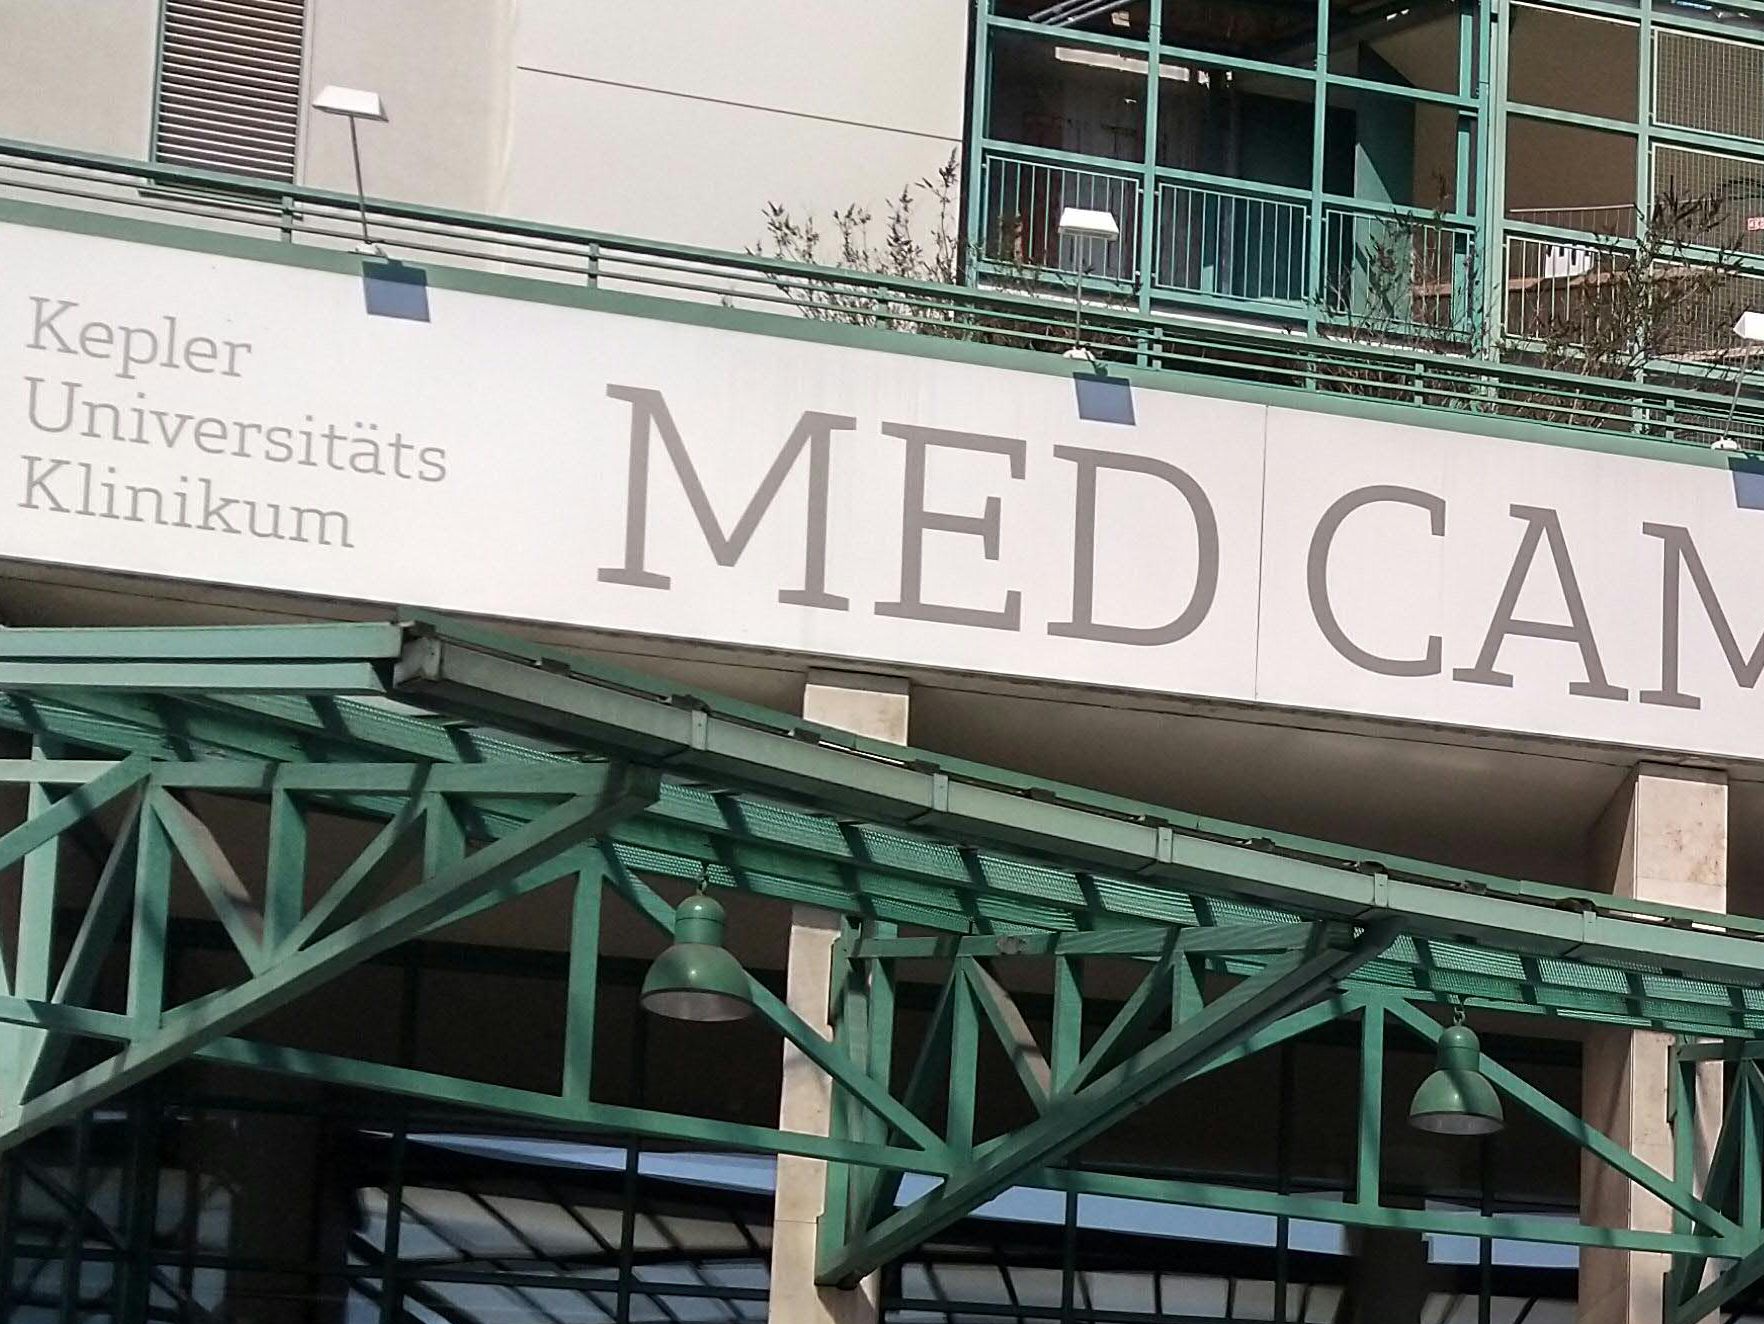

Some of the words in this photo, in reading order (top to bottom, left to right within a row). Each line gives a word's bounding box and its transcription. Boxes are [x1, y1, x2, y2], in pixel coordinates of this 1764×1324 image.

[25, 296, 253, 380] Kepler
[25, 376, 448, 483] Universitäts
[18, 455, 355, 549] Klinikum
[597, 384, 1219, 646] MED
